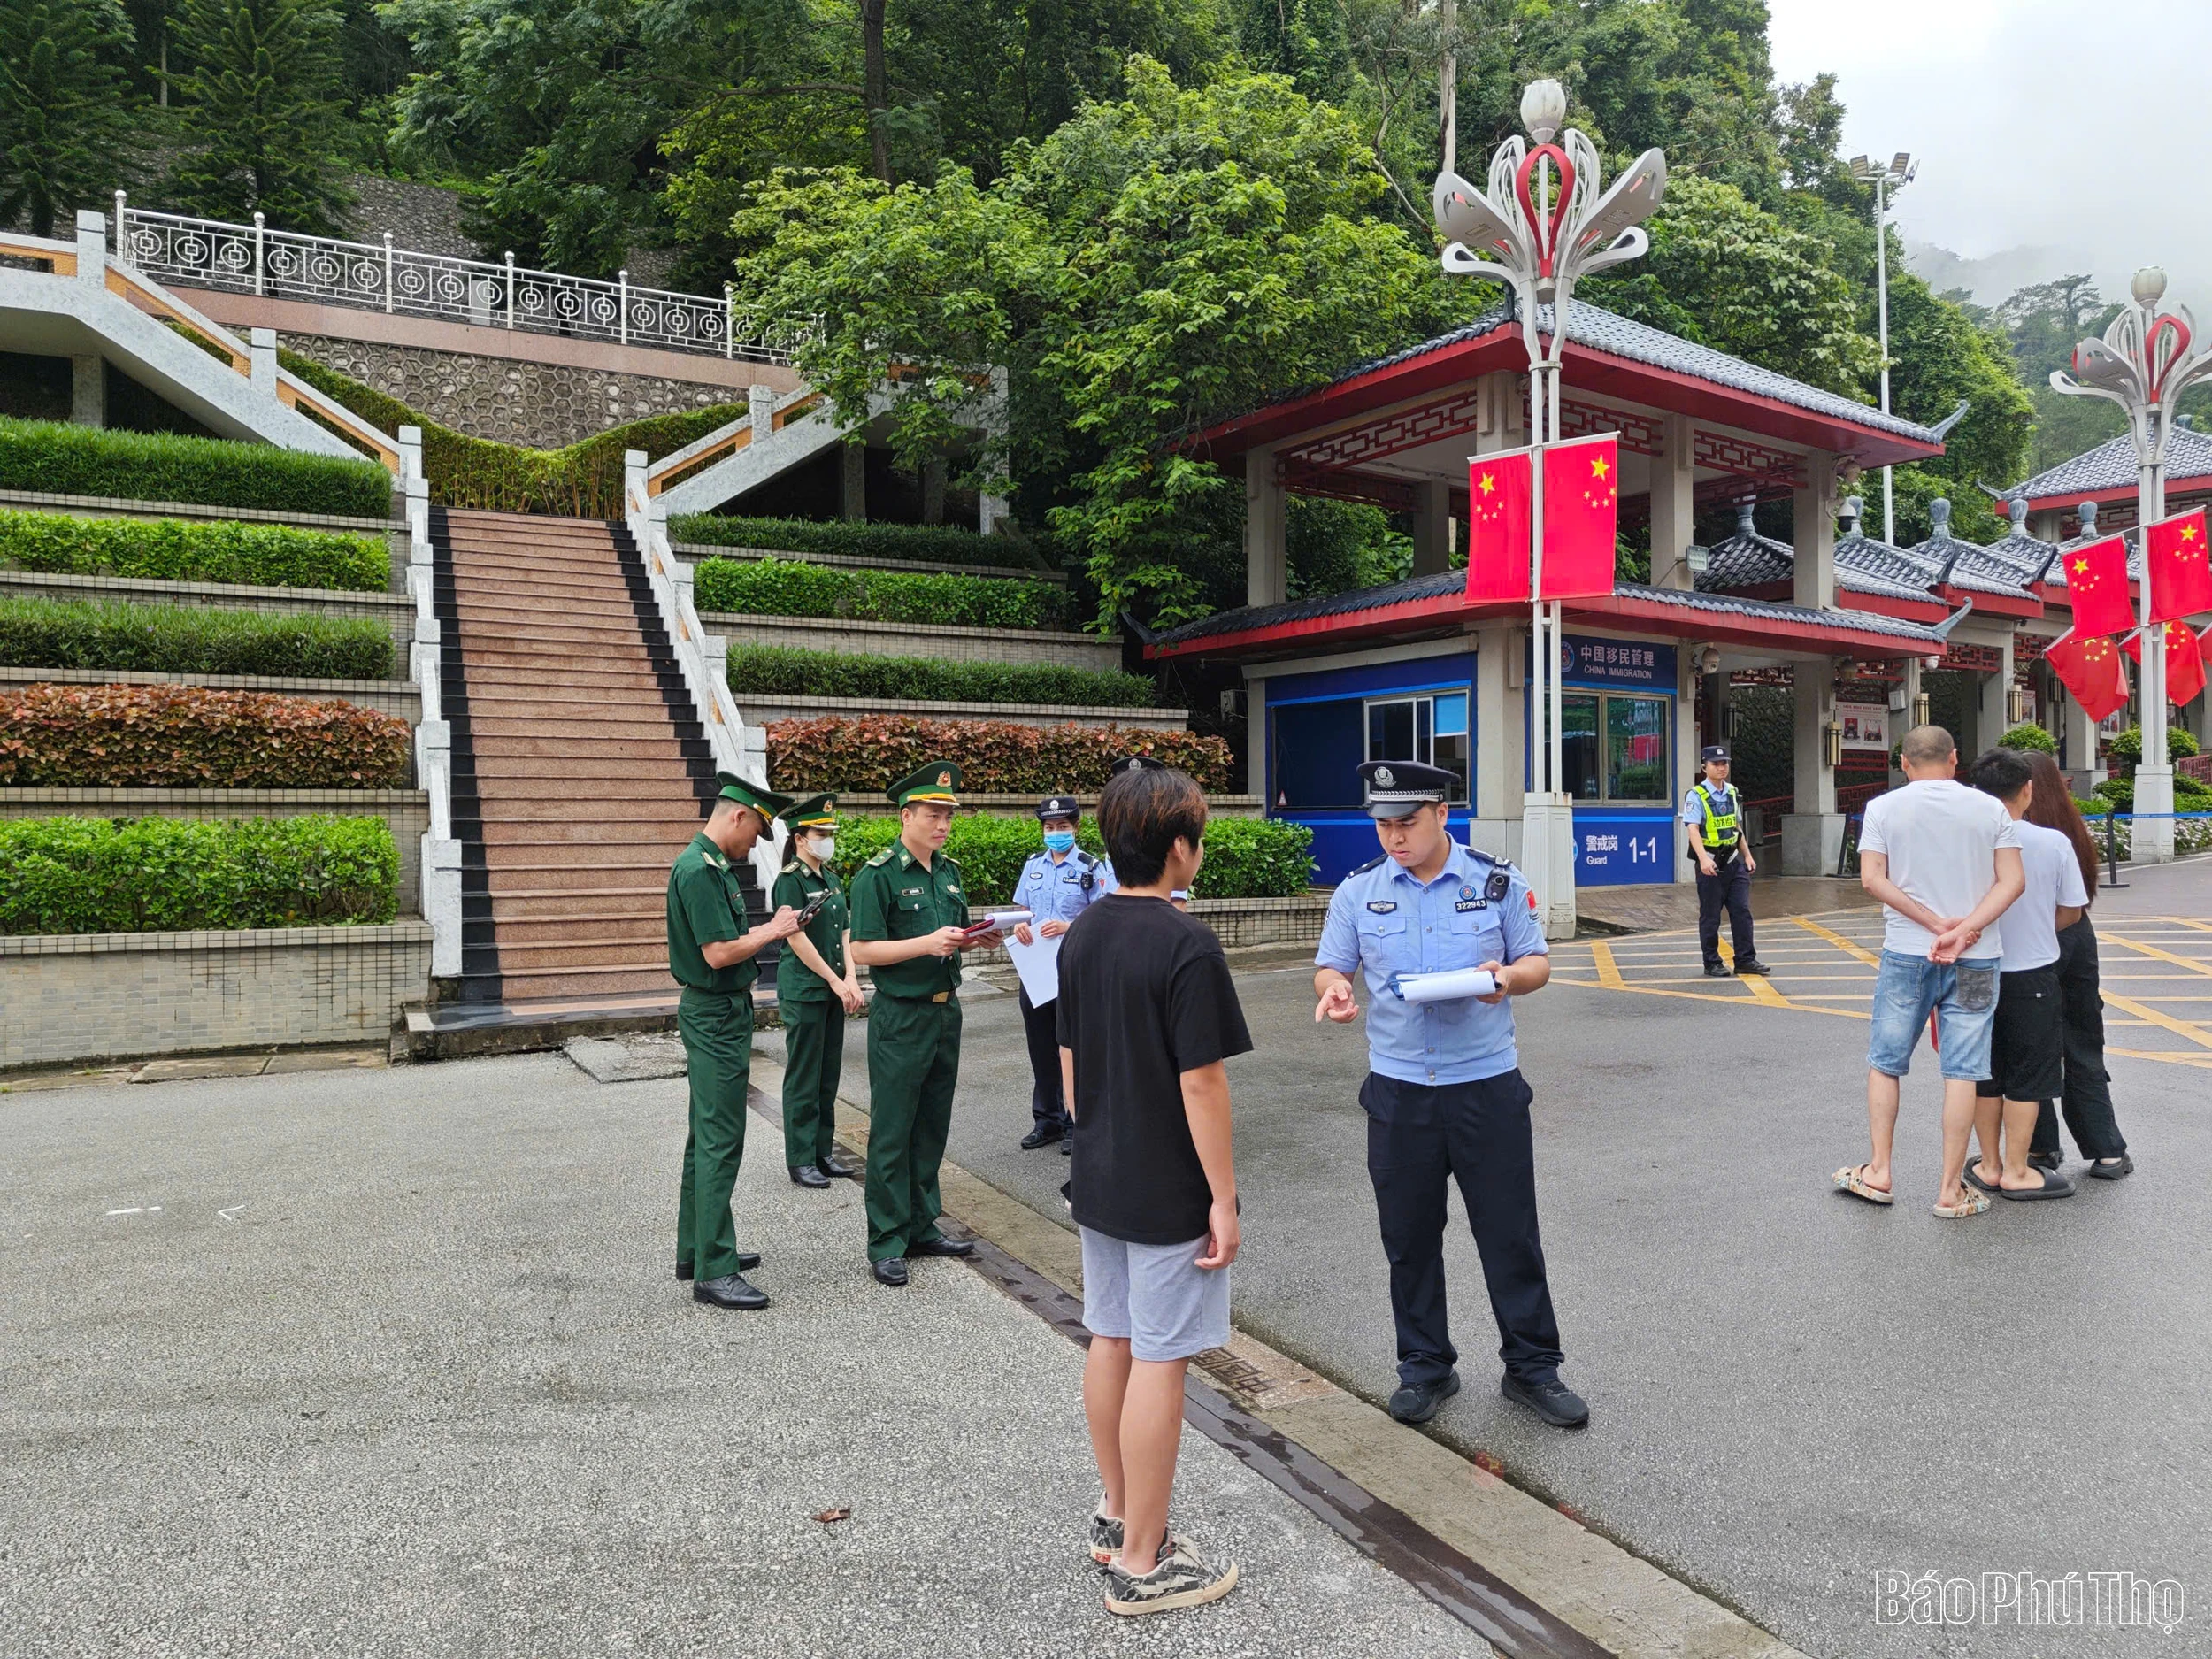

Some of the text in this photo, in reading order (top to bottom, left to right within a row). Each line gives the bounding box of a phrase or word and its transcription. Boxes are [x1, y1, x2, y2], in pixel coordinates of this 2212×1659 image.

[1581, 644, 1655, 666] 中国移民管理
[1584, 664, 1652, 679] CHINA IMMIGRATION
[1586, 834, 1618, 852] 警戒岗
[1629, 837, 1656, 863] 1-1
[1586, 856, 1608, 864] Guard
[1456, 900, 1486, 910] 322943
